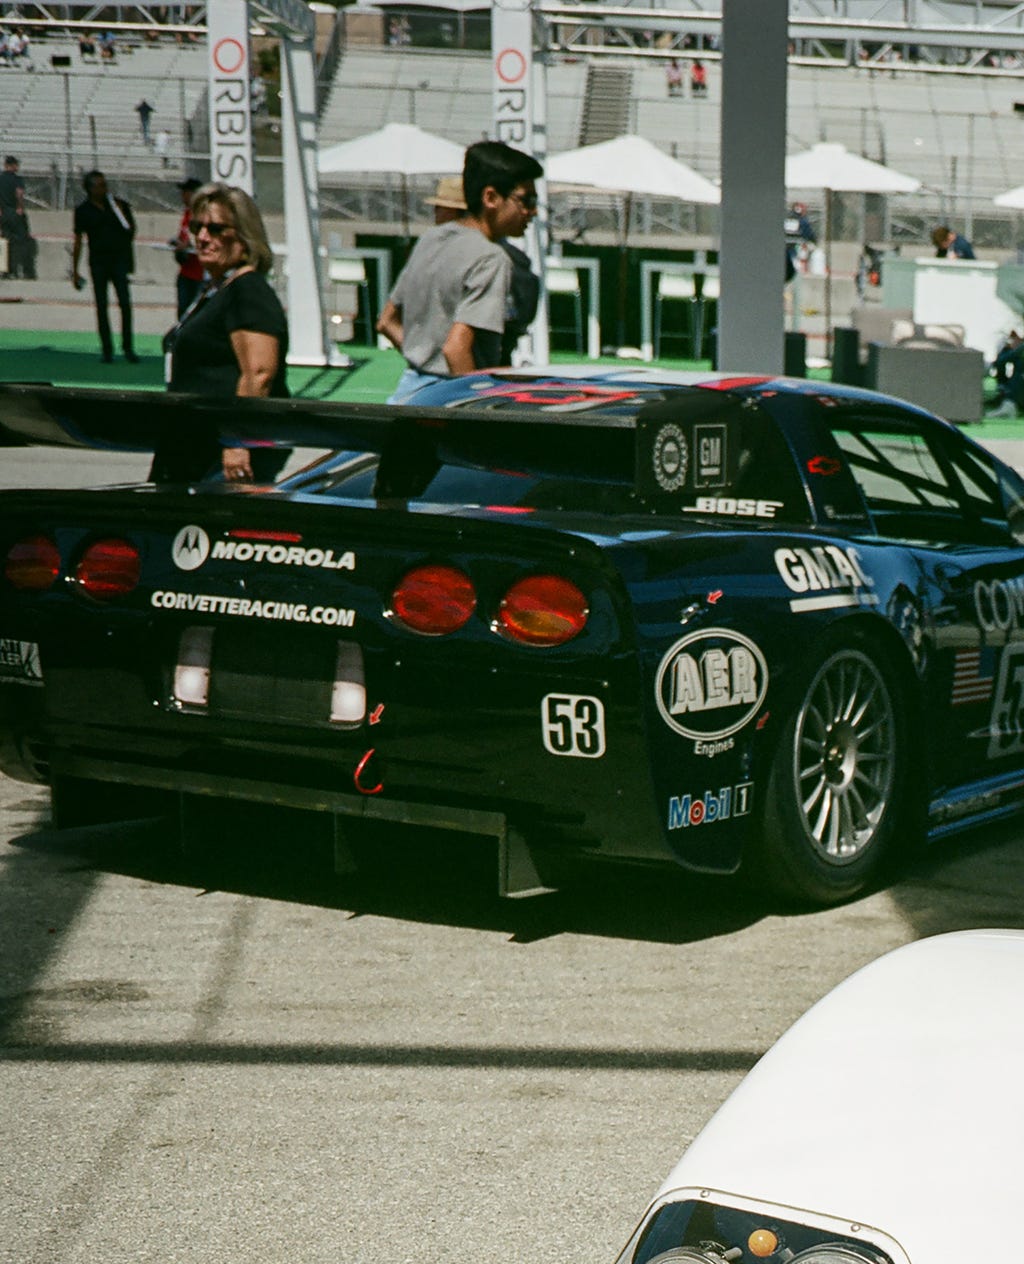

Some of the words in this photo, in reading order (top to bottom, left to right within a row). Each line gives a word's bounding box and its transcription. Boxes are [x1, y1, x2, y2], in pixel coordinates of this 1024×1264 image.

[213, 38, 247, 178] ORBIS
[700, 437, 721, 466] GM
[681, 496, 785, 518] BOSE
[211, 540, 356, 571] MOTOROLA
[774, 545, 875, 592] GMAC
[151, 590, 356, 627] CORVETTERACING.COM
[670, 646, 759, 715] AER
[546, 696, 602, 756] 53
[693, 737, 735, 759] Engines
[668, 785, 732, 830] Mobil
